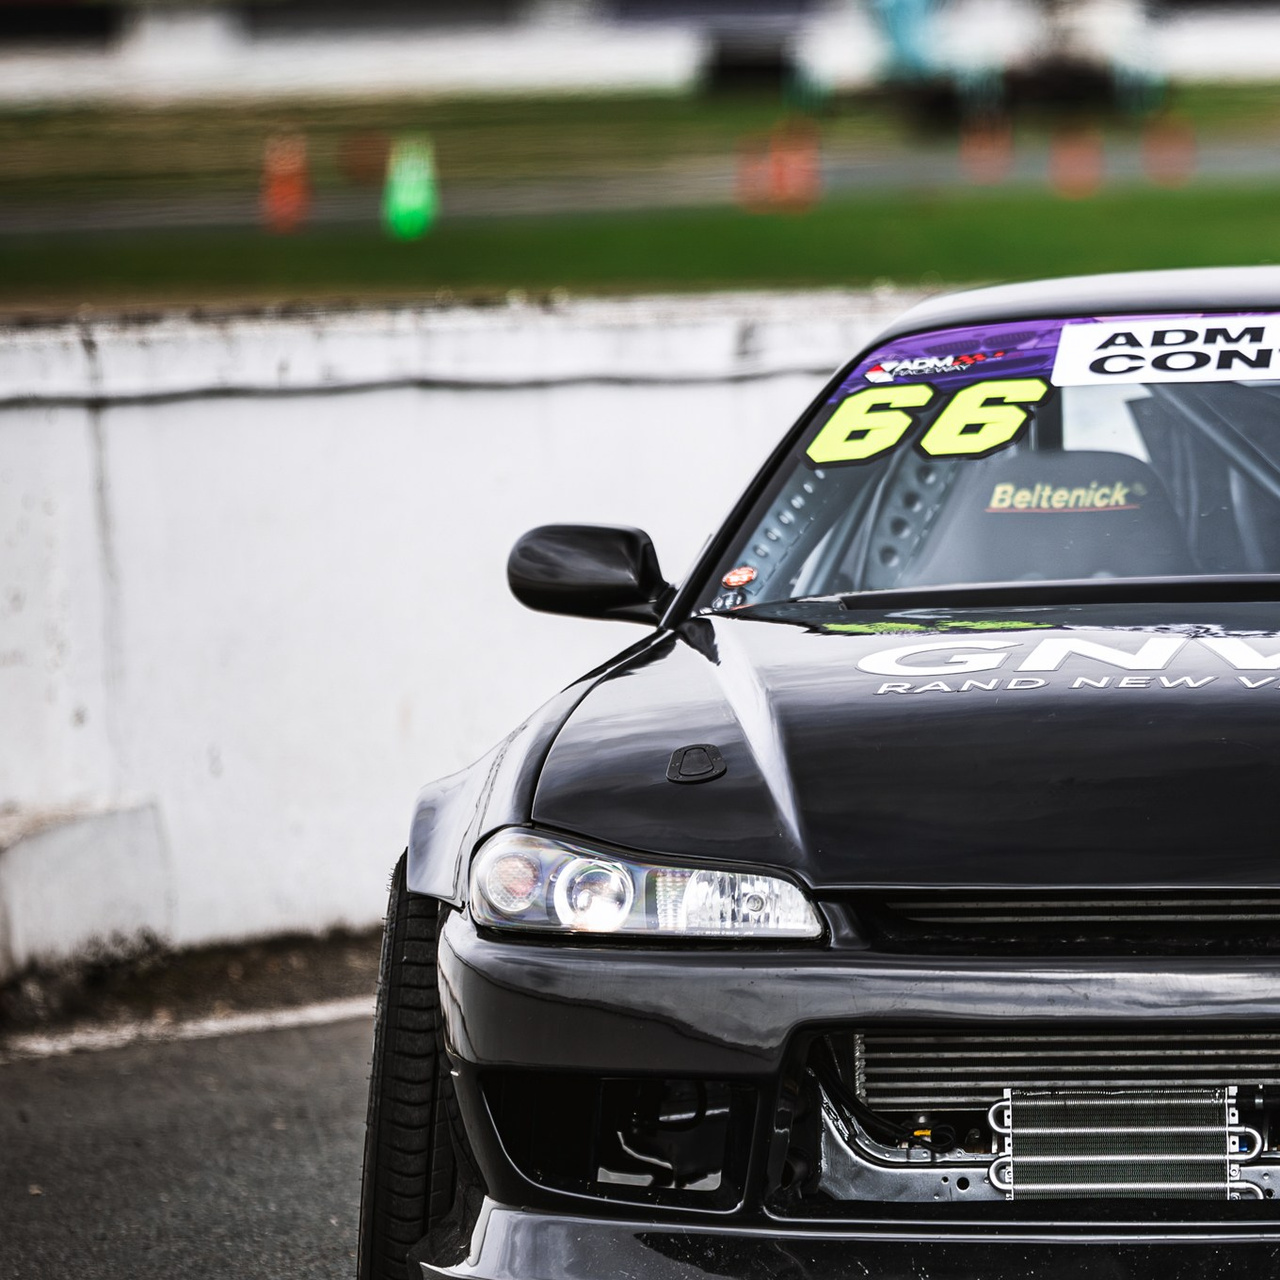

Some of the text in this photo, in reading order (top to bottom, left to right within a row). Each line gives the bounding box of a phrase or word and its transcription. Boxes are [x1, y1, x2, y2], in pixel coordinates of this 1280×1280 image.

[1094, 326, 1265, 350] ADM
[893, 355, 954, 371] ADM
[806, 379, 1048, 463] 66
[989, 481, 1130, 508] Beltenick
[1074, 676, 1216, 690] NEW
